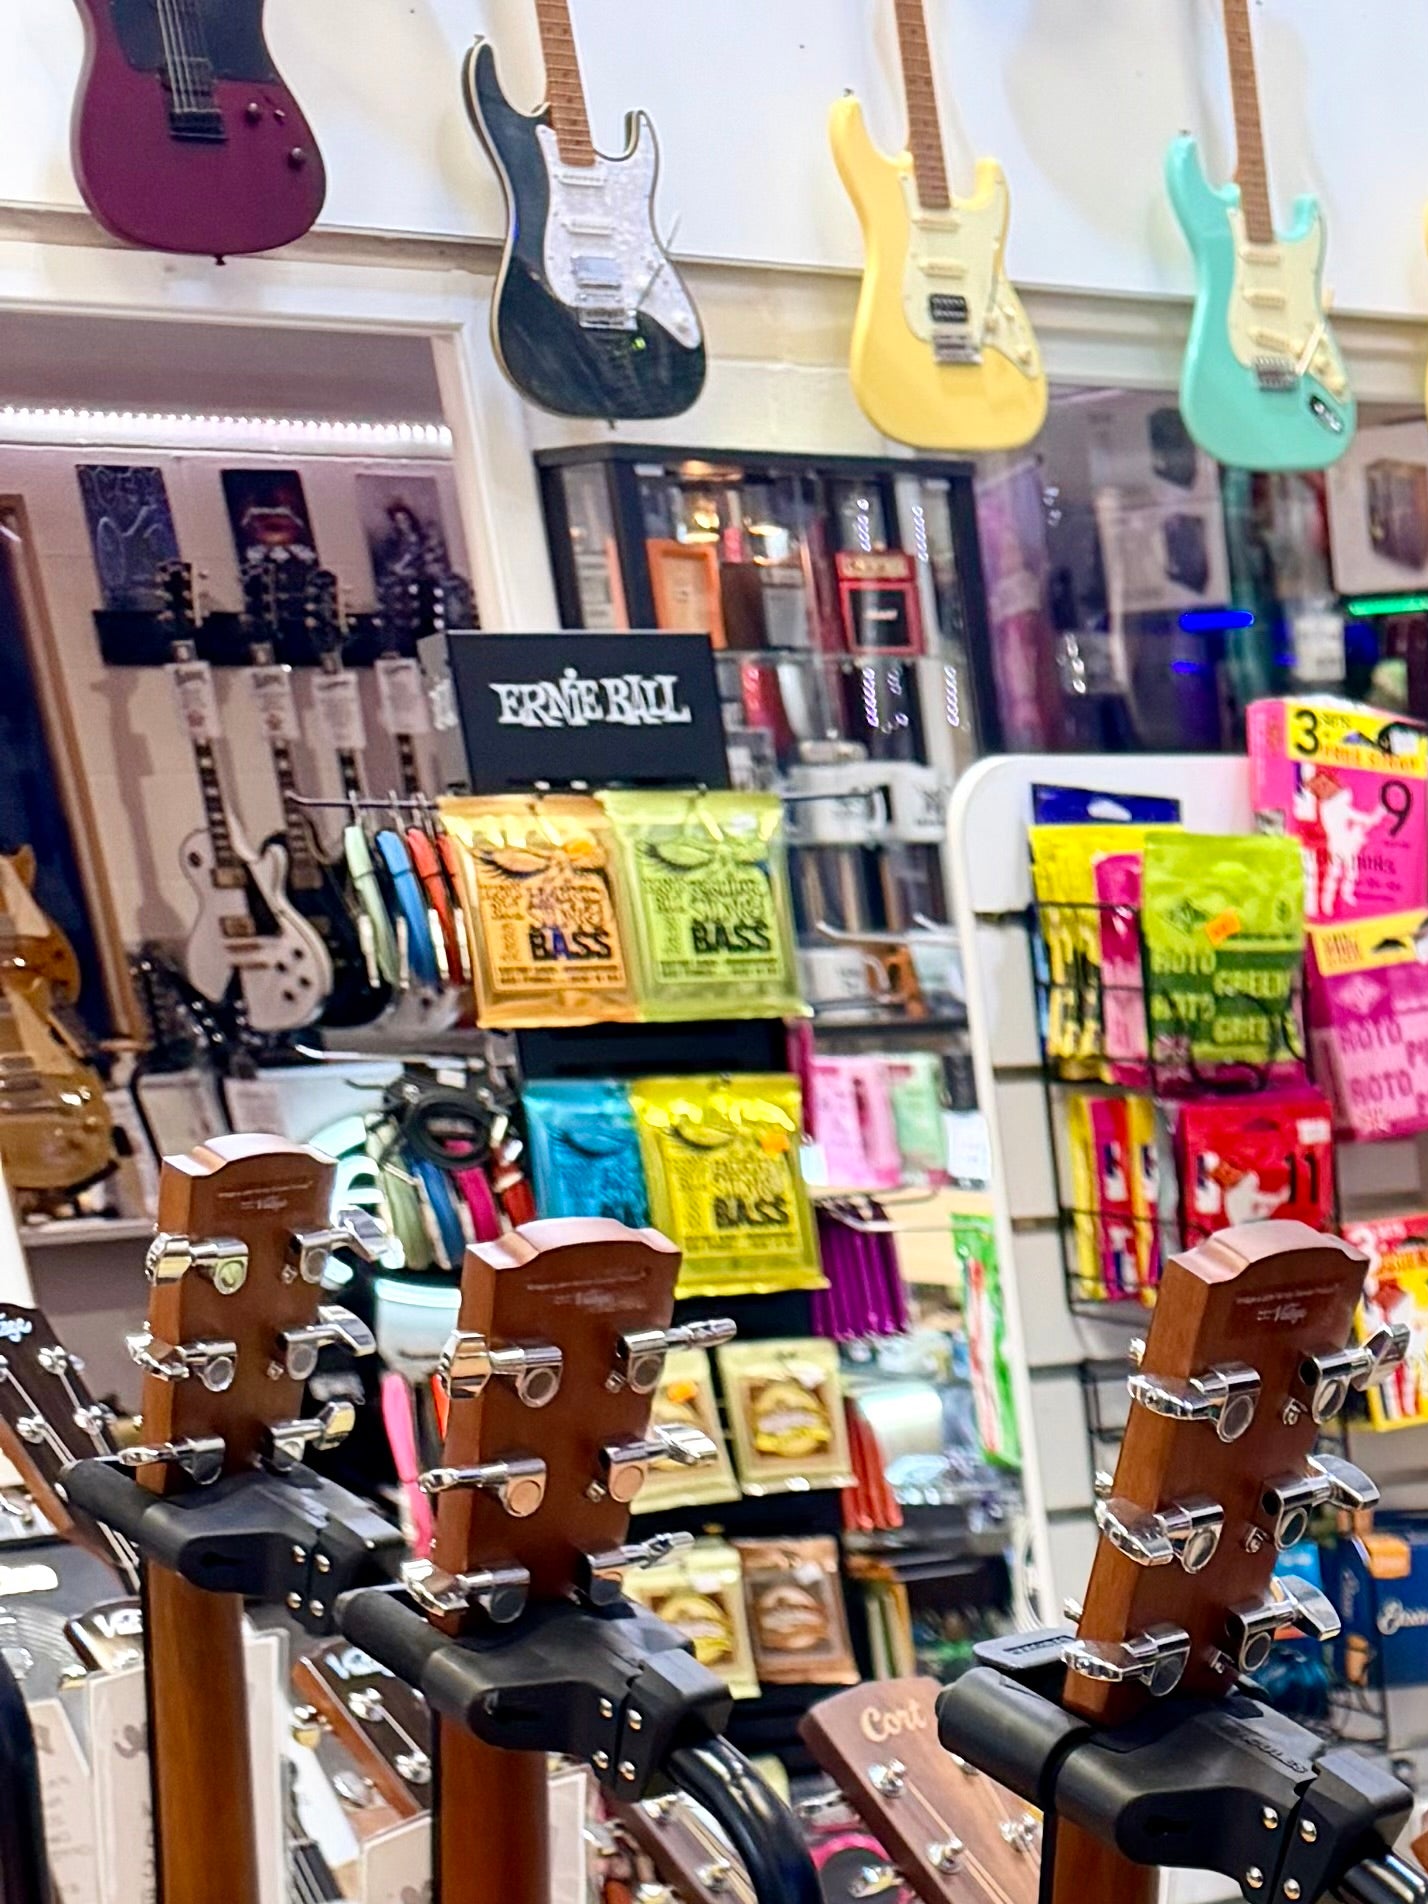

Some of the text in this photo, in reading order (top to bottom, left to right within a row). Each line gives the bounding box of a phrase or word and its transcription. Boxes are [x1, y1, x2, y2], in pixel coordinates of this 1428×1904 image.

[599, 674, 692, 726] BALL
[1293, 709, 1320, 756] 3
[1380, 780, 1414, 837] 9
[528, 922, 612, 962] BASS
[691, 913, 772, 957] BASS
[713, 1195, 789, 1229] BASS
[860, 1698, 927, 1742] Cort
